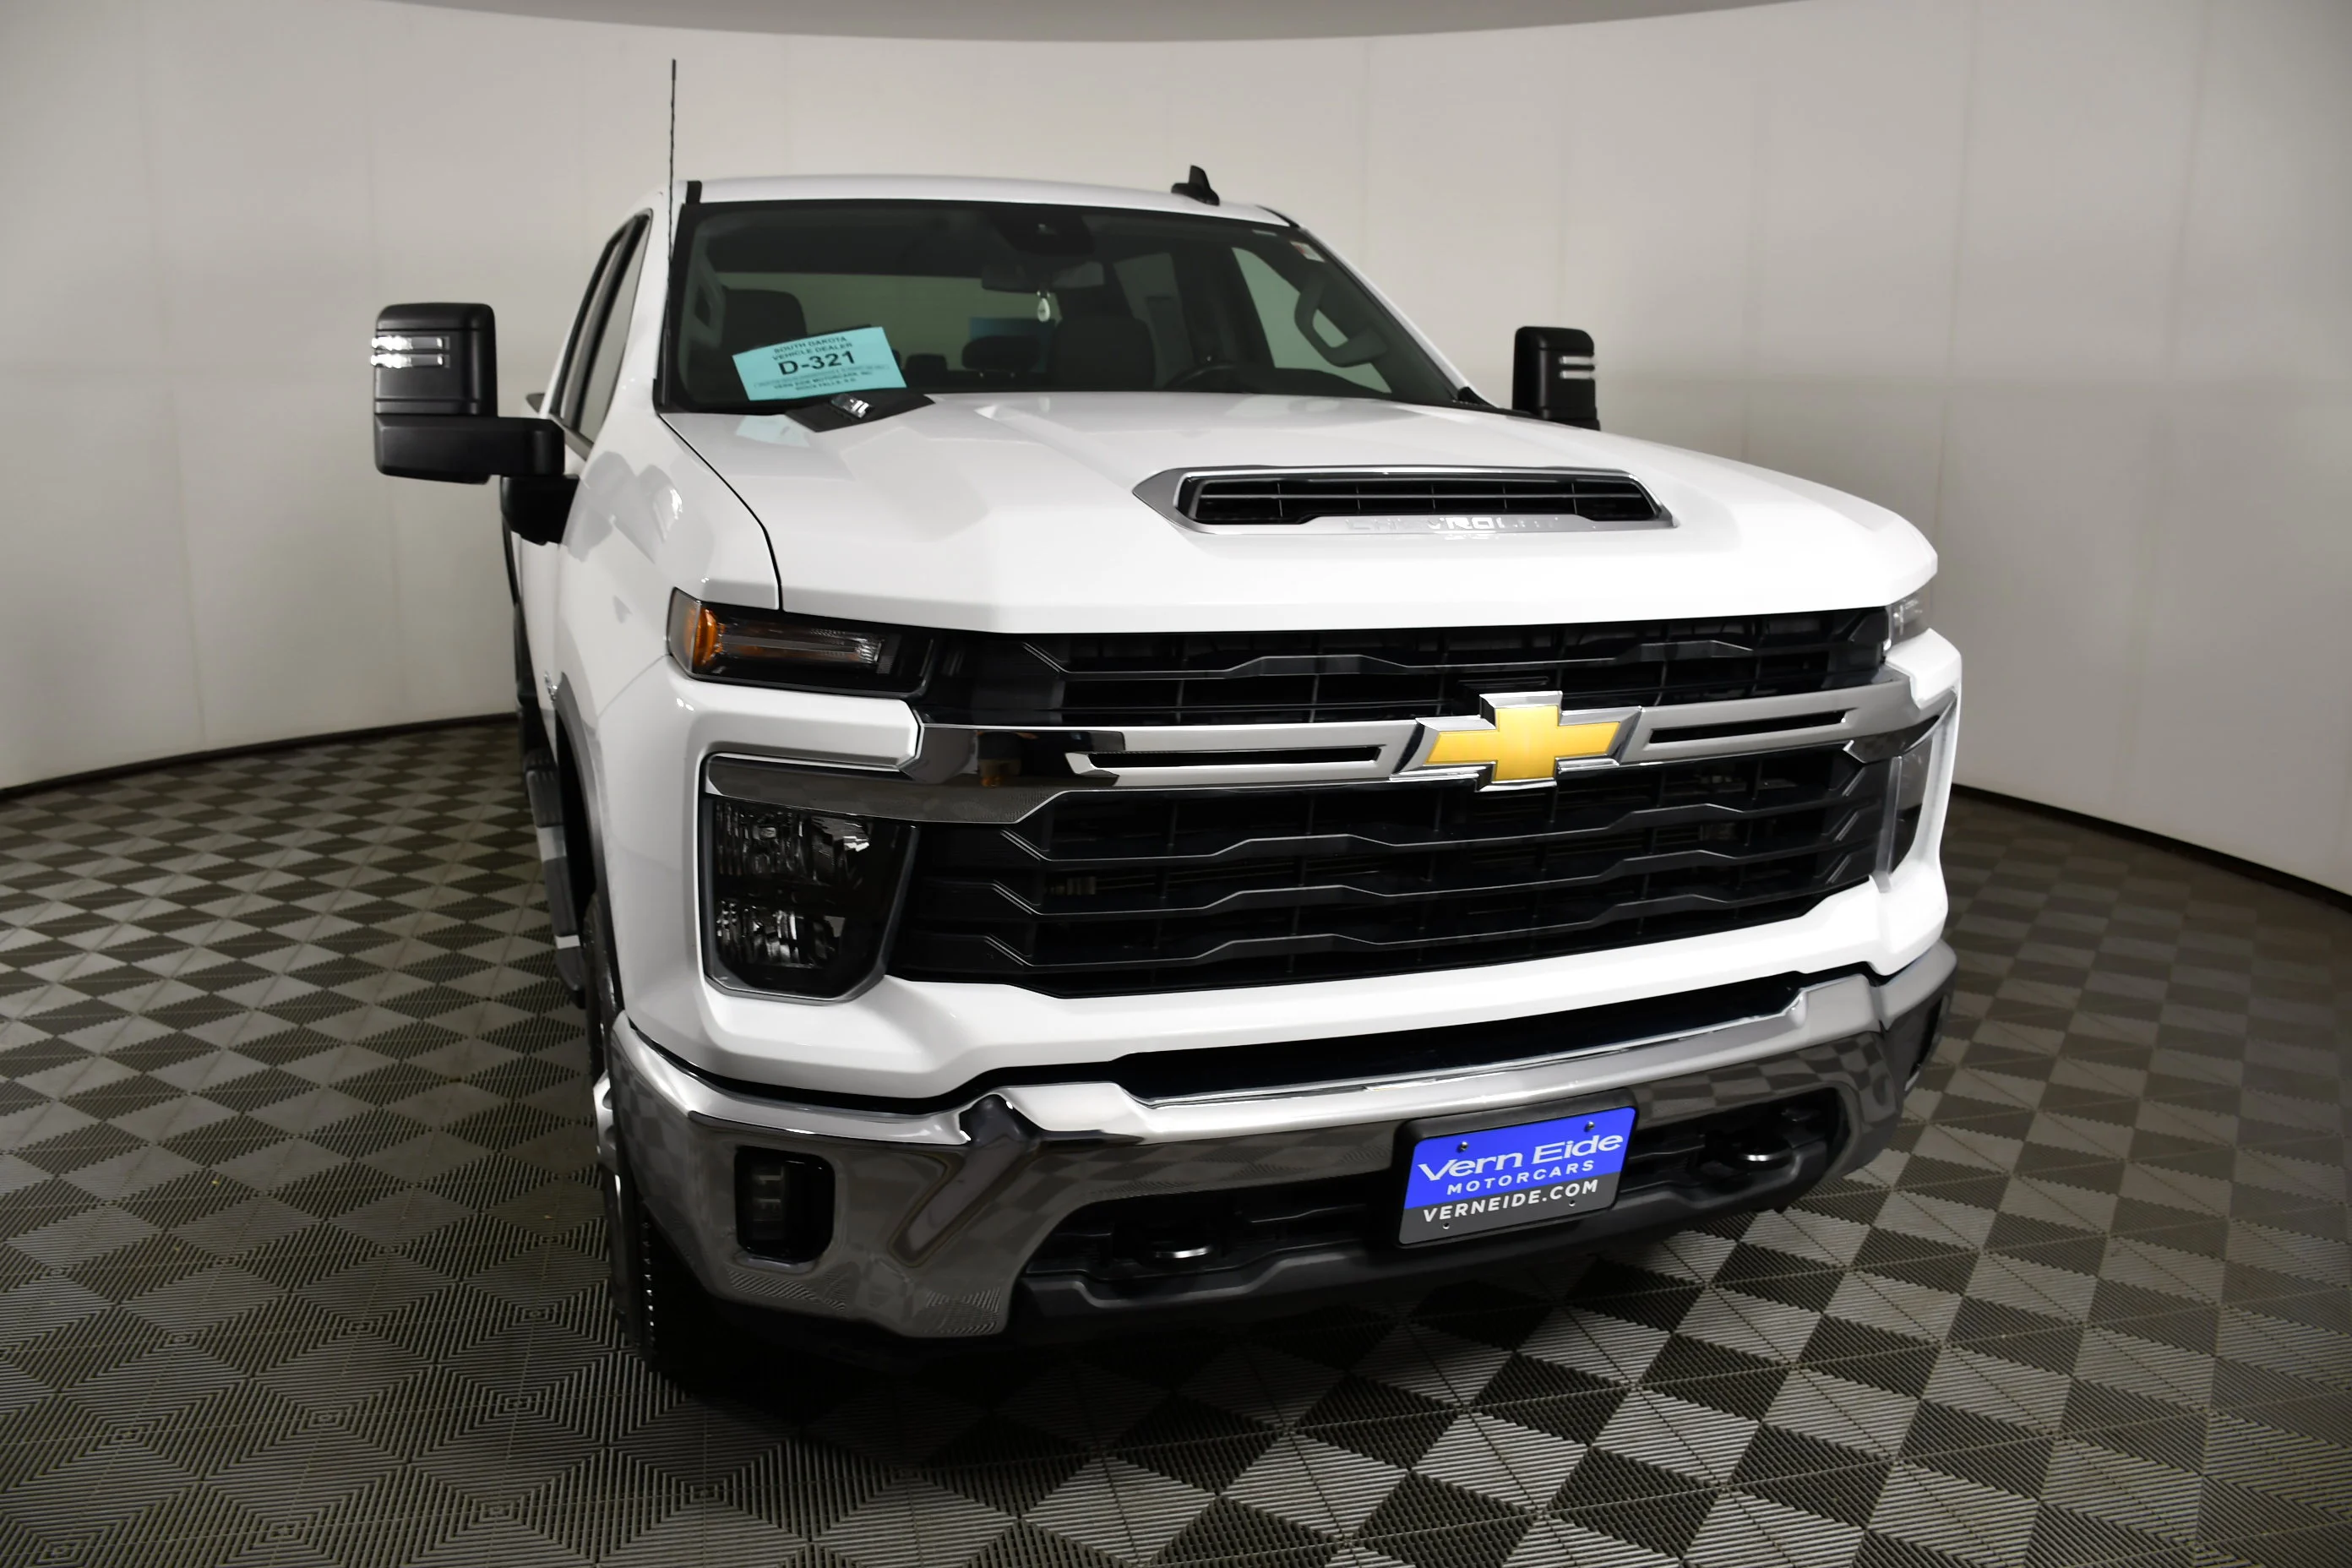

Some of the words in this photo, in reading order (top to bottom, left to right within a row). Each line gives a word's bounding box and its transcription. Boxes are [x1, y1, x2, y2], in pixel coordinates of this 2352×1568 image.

[771, 348, 812, 361] VEHICLE
[814, 342, 853, 353] DEALER
[773, 341, 806, 354] SOUTH
[808, 335, 847, 347] DAKOTA
[777, 350, 856, 376] D-321
[1418, 1152, 1523, 1182] Vern
[1532, 1134, 1624, 1165] Eide
[1446, 1159, 1595, 1195] MOTORCARS
[1423, 1179, 1598, 1223] VERNEIDE.COM
